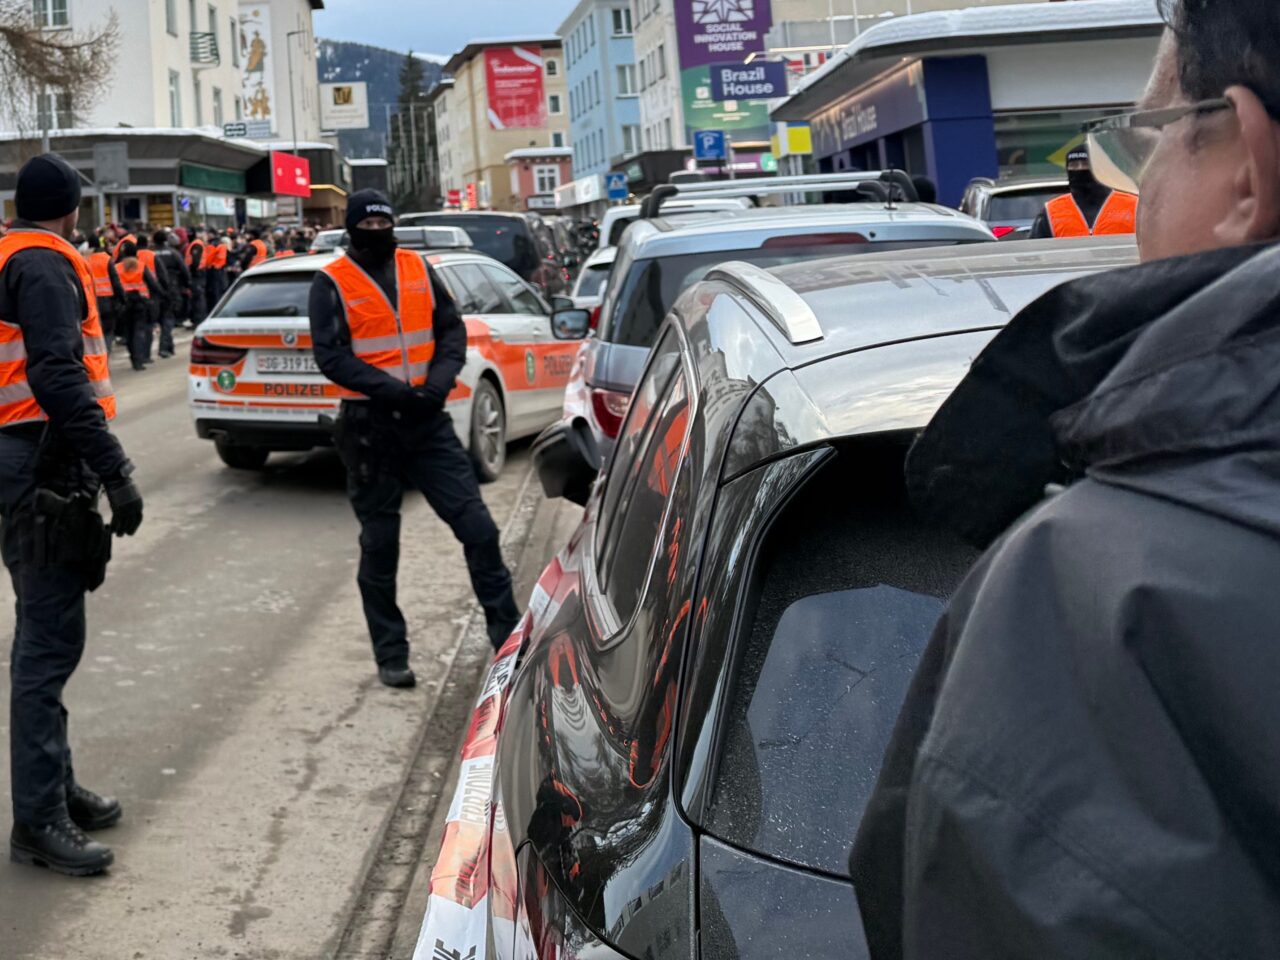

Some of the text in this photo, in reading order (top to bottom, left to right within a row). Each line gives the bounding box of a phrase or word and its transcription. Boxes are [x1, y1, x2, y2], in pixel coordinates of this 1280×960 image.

[706, 23, 743, 33] SOCIAL
[694, 31, 757, 43] INNOVATION
[708, 41, 744, 52] HOUSE
[721, 67, 765, 83] Brazil
[723, 83, 774, 96] House
[264, 383, 324, 397] POLIZEI
